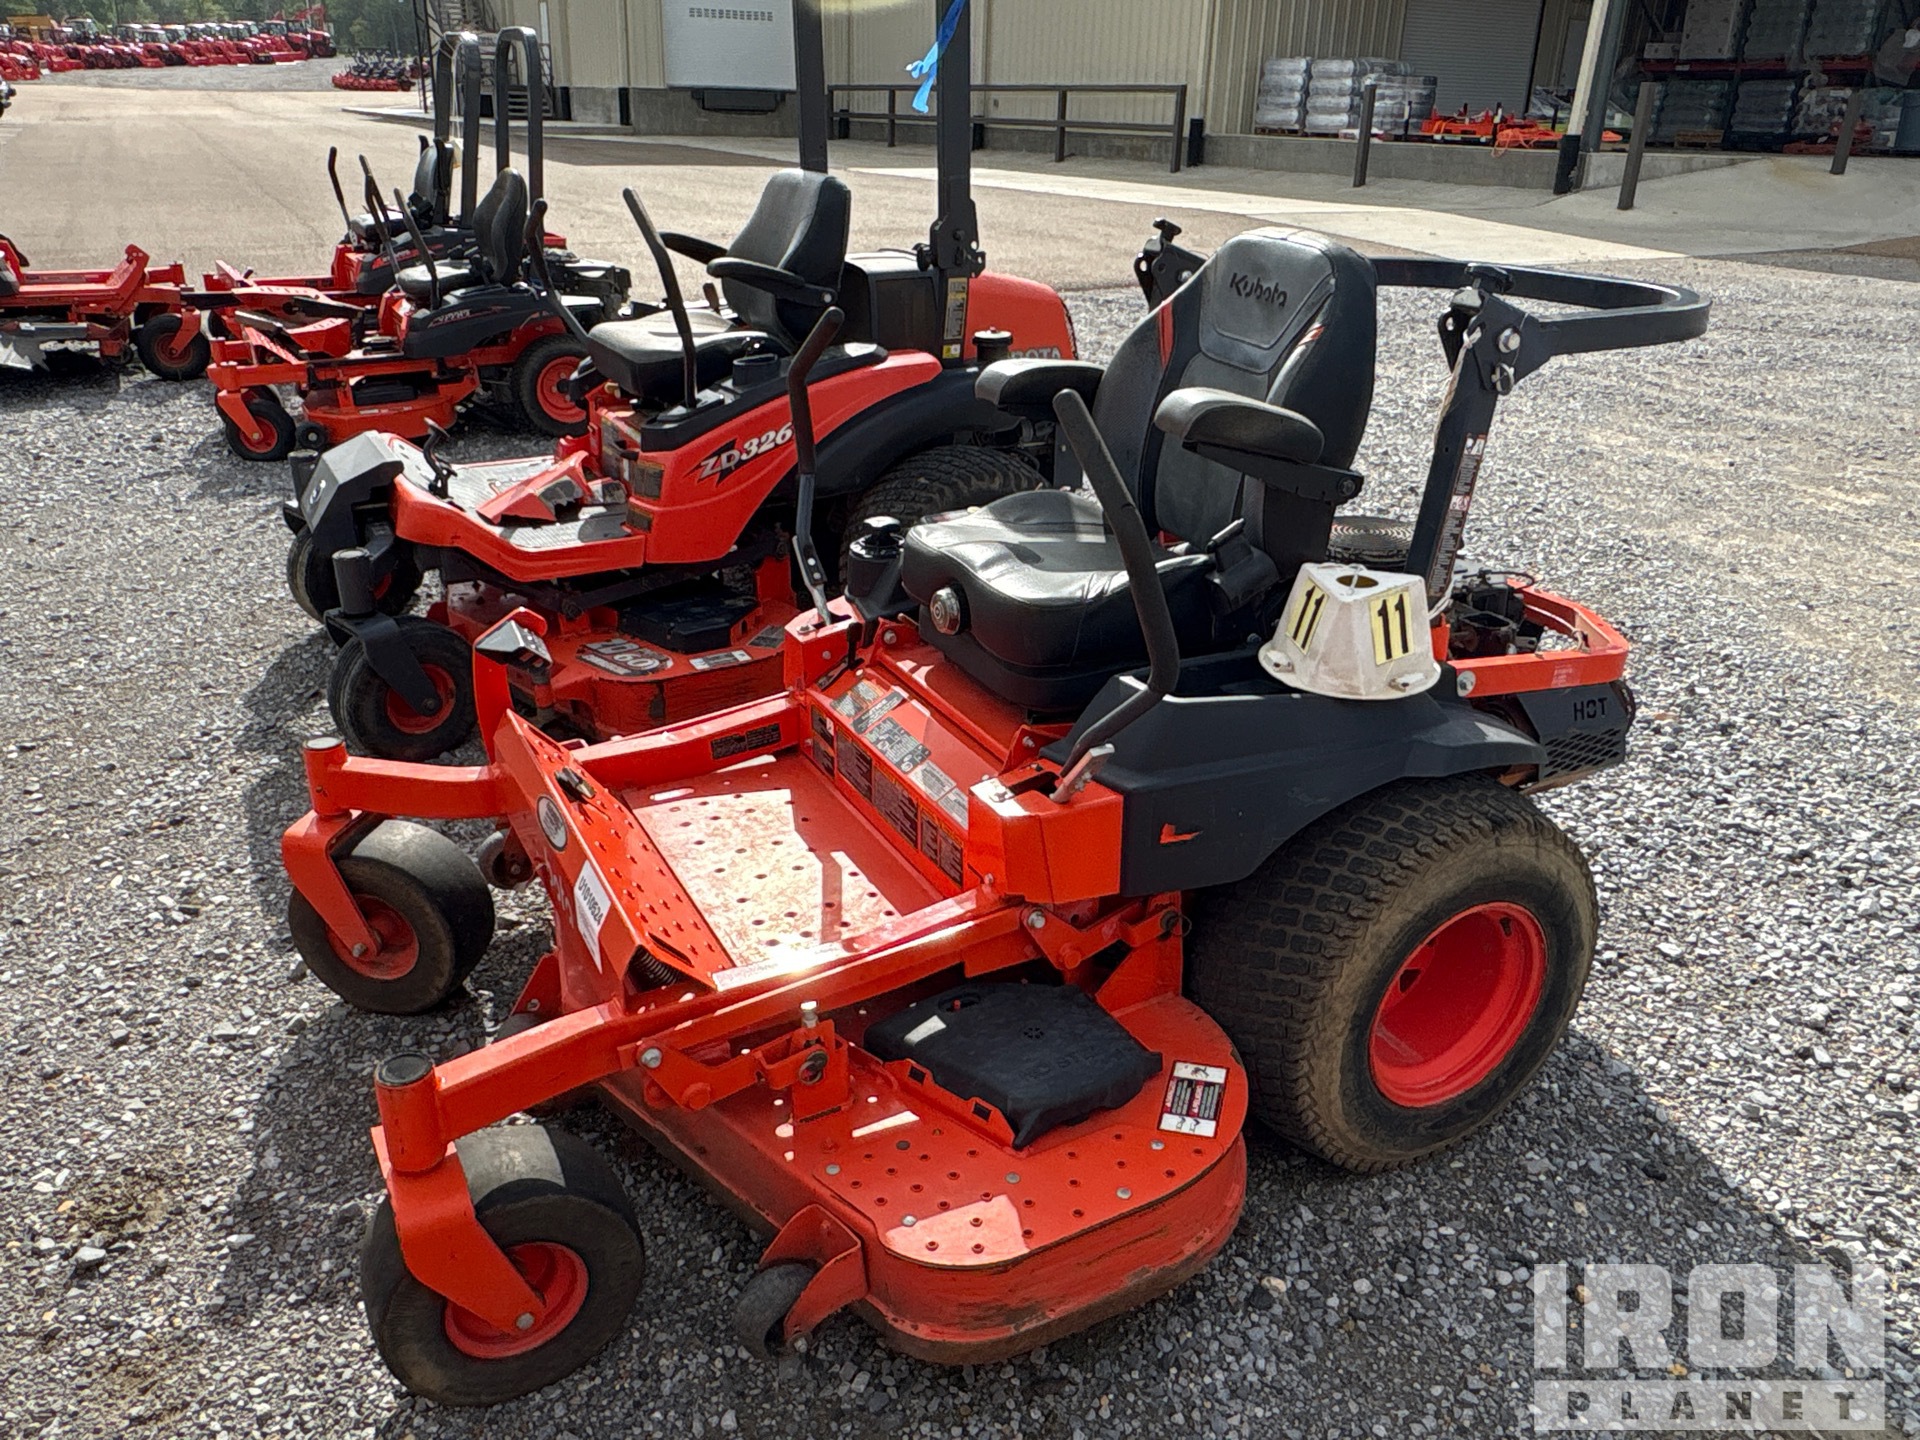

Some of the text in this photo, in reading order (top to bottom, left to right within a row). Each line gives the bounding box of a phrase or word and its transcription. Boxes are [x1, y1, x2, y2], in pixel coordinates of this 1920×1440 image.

[1229, 272, 1288, 308] Kubota
[700, 421, 794, 480] ZD326
[1292, 584, 1326, 651] 11
[1377, 593, 1409, 661] 11
[1573, 697, 1608, 722] HOT
